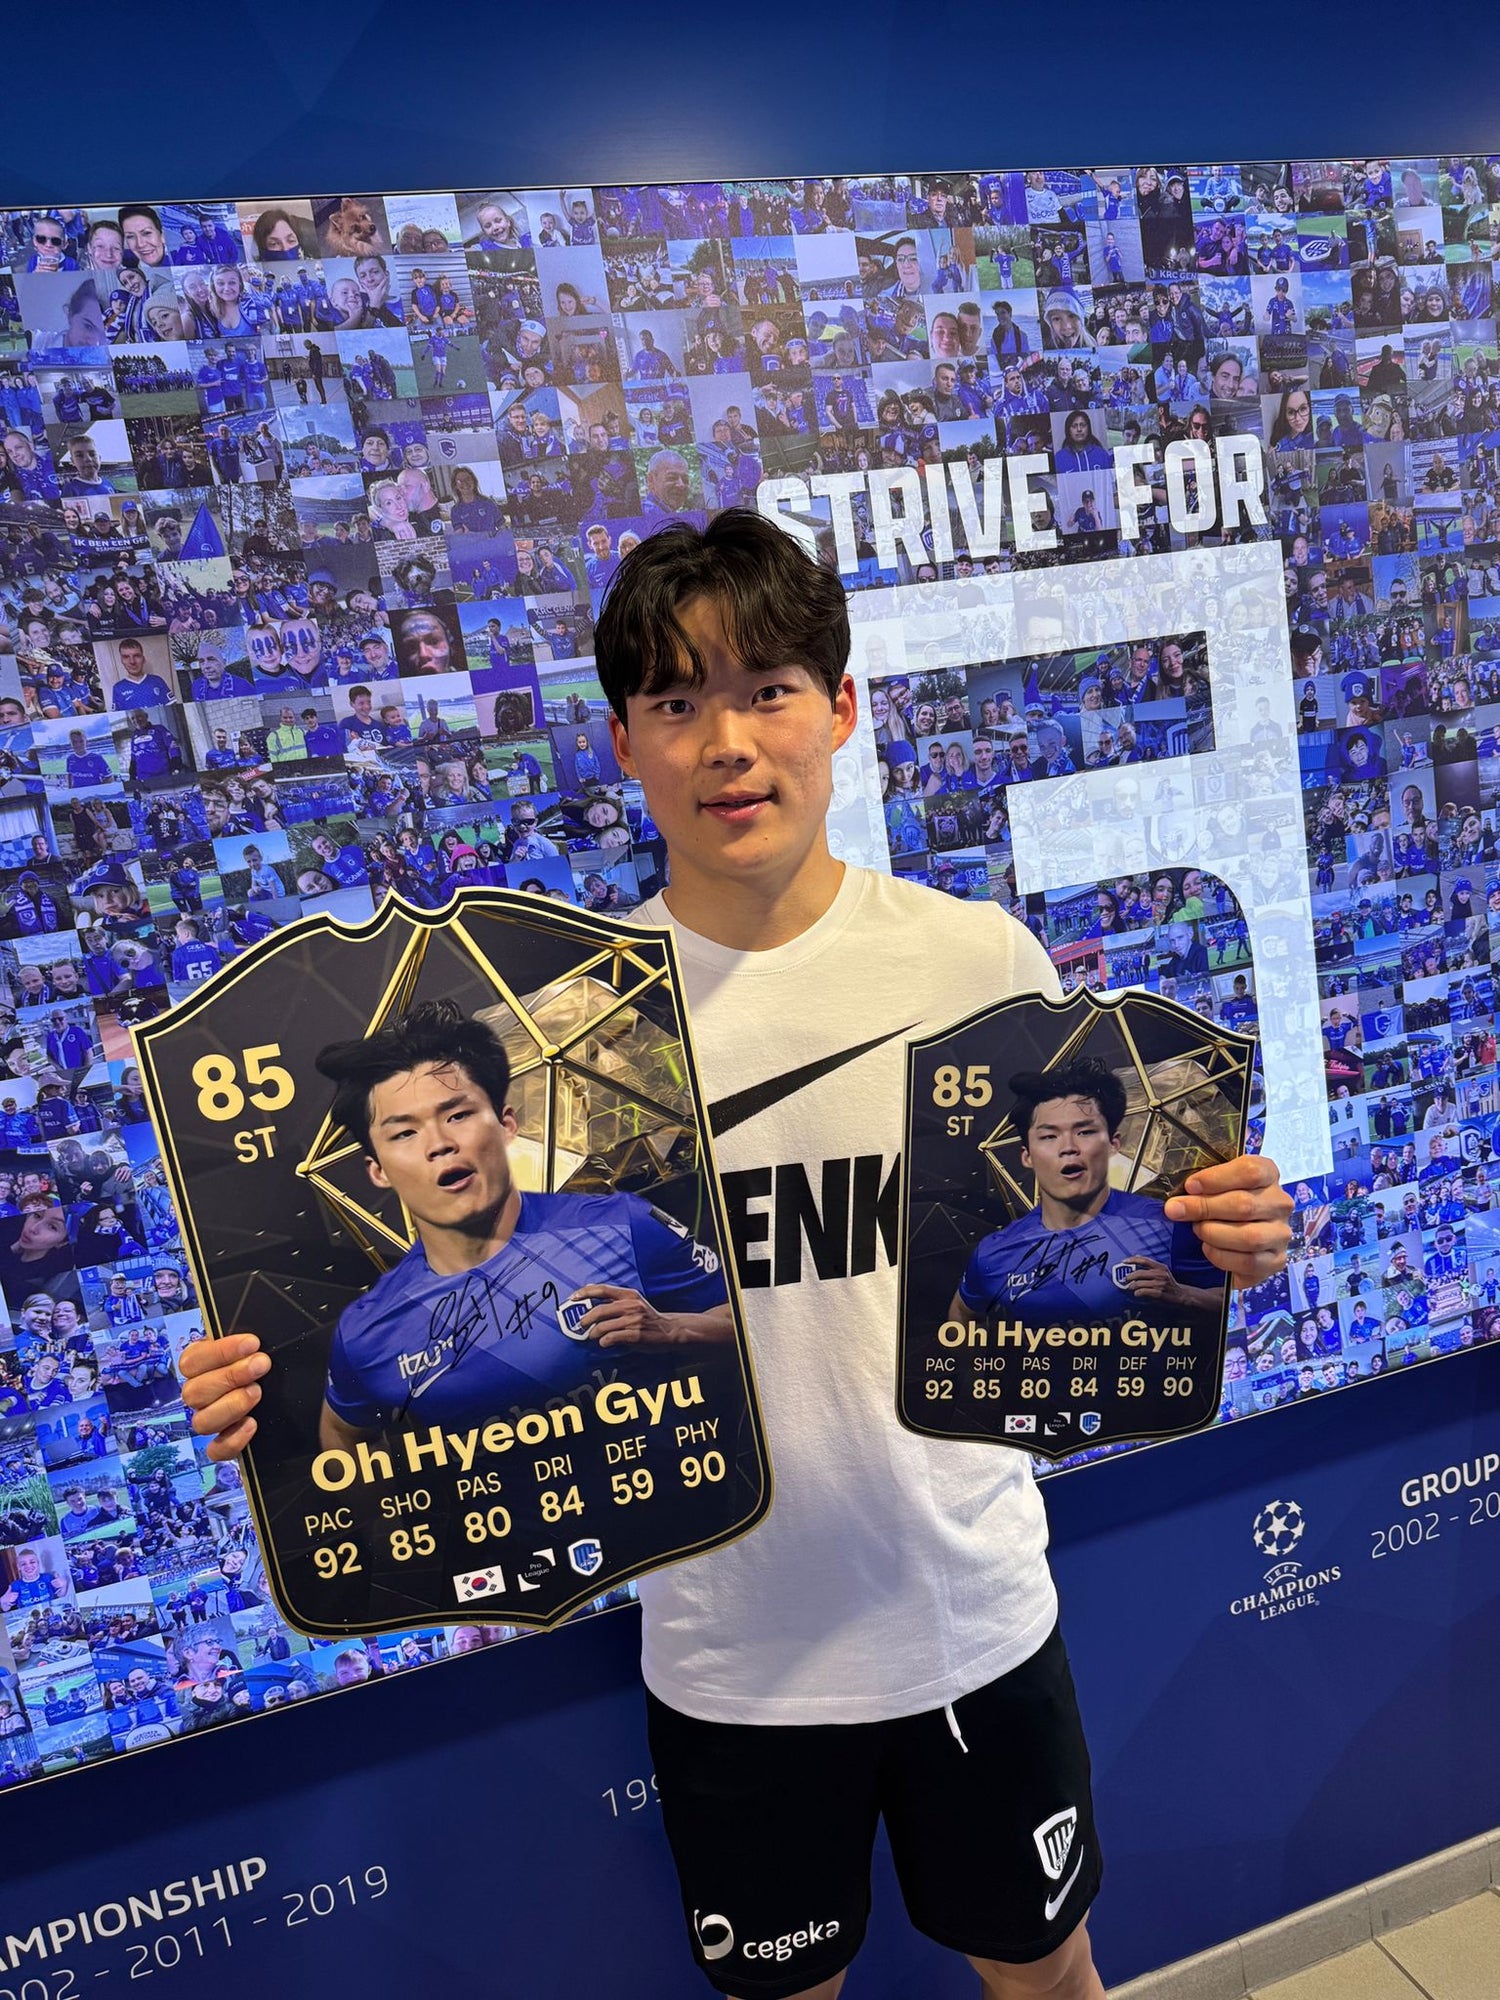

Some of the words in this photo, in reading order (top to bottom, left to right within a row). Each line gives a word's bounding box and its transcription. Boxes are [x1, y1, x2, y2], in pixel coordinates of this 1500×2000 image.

[757, 453, 1058, 574] STRIVE
[1113, 434, 1268, 540] FOR
[88, 539, 109, 547] BEN
[186, 960, 213, 980] 65
[192, 1043, 295, 1121] 85
[932, 1065, 993, 1108] 85
[234, 1125, 277, 1163] ST
[946, 1115, 975, 1137] ST
[505, 1280, 560, 1340] #9
[938, 1320, 988, 1349] Oh
[997, 1320, 1111, 1353] Hyeon
[1120, 1319, 1192, 1353] Gyu
[925, 1358, 956, 1372] PAC
[973, 1357, 1006, 1371] SHO
[1022, 1356, 1051, 1371] PAS
[1072, 1356, 1098, 1370] DRI
[1119, 1356, 1148, 1370] DEF
[1166, 1356, 1197, 1370] PHY
[925, 1379, 954, 1400] 92
[972, 1379, 1001, 1399] 85
[1020, 1378, 1051, 1399] 80
[1069, 1377, 1098, 1397] 84
[1116, 1377, 1145, 1397] 59
[1163, 1376, 1194, 1397] 90
[311, 1441, 394, 1492] Oh
[403, 1405, 585, 1473] Hyeon
[595, 1375, 705, 1426] Gyu
[304, 1507, 354, 1537] PAC
[380, 1489, 432, 1519] SHO
[456, 1472, 502, 1501] PAS
[534, 1453, 573, 1482] DRI
[605, 1435, 648, 1465] DEF
[675, 1417, 720, 1448] PHY
[1400, 1453, 1500, 1507] GROUP
[313, 1541, 363, 1580] 92
[389, 1523, 437, 1562] 85
[464, 1505, 513, 1544] 80
[540, 1484, 585, 1523] 84
[610, 1468, 655, 1506] 59
[680, 1450, 727, 1489] 90
[1371, 1512, 1440, 1559] 2002
[524, 1567, 550, 1578] League
[529, 1562, 542, 1570] Pro
[1265, 1565, 1299, 1584] UEFA
[1230, 1565, 1342, 1615] CHAMPIONS
[1259, 1592, 1316, 1621] LEAGUE
[125, 1916, 232, 1979] 2011
[282, 1865, 388, 1927] 2019
[742, 1920, 840, 1962] cegeka
